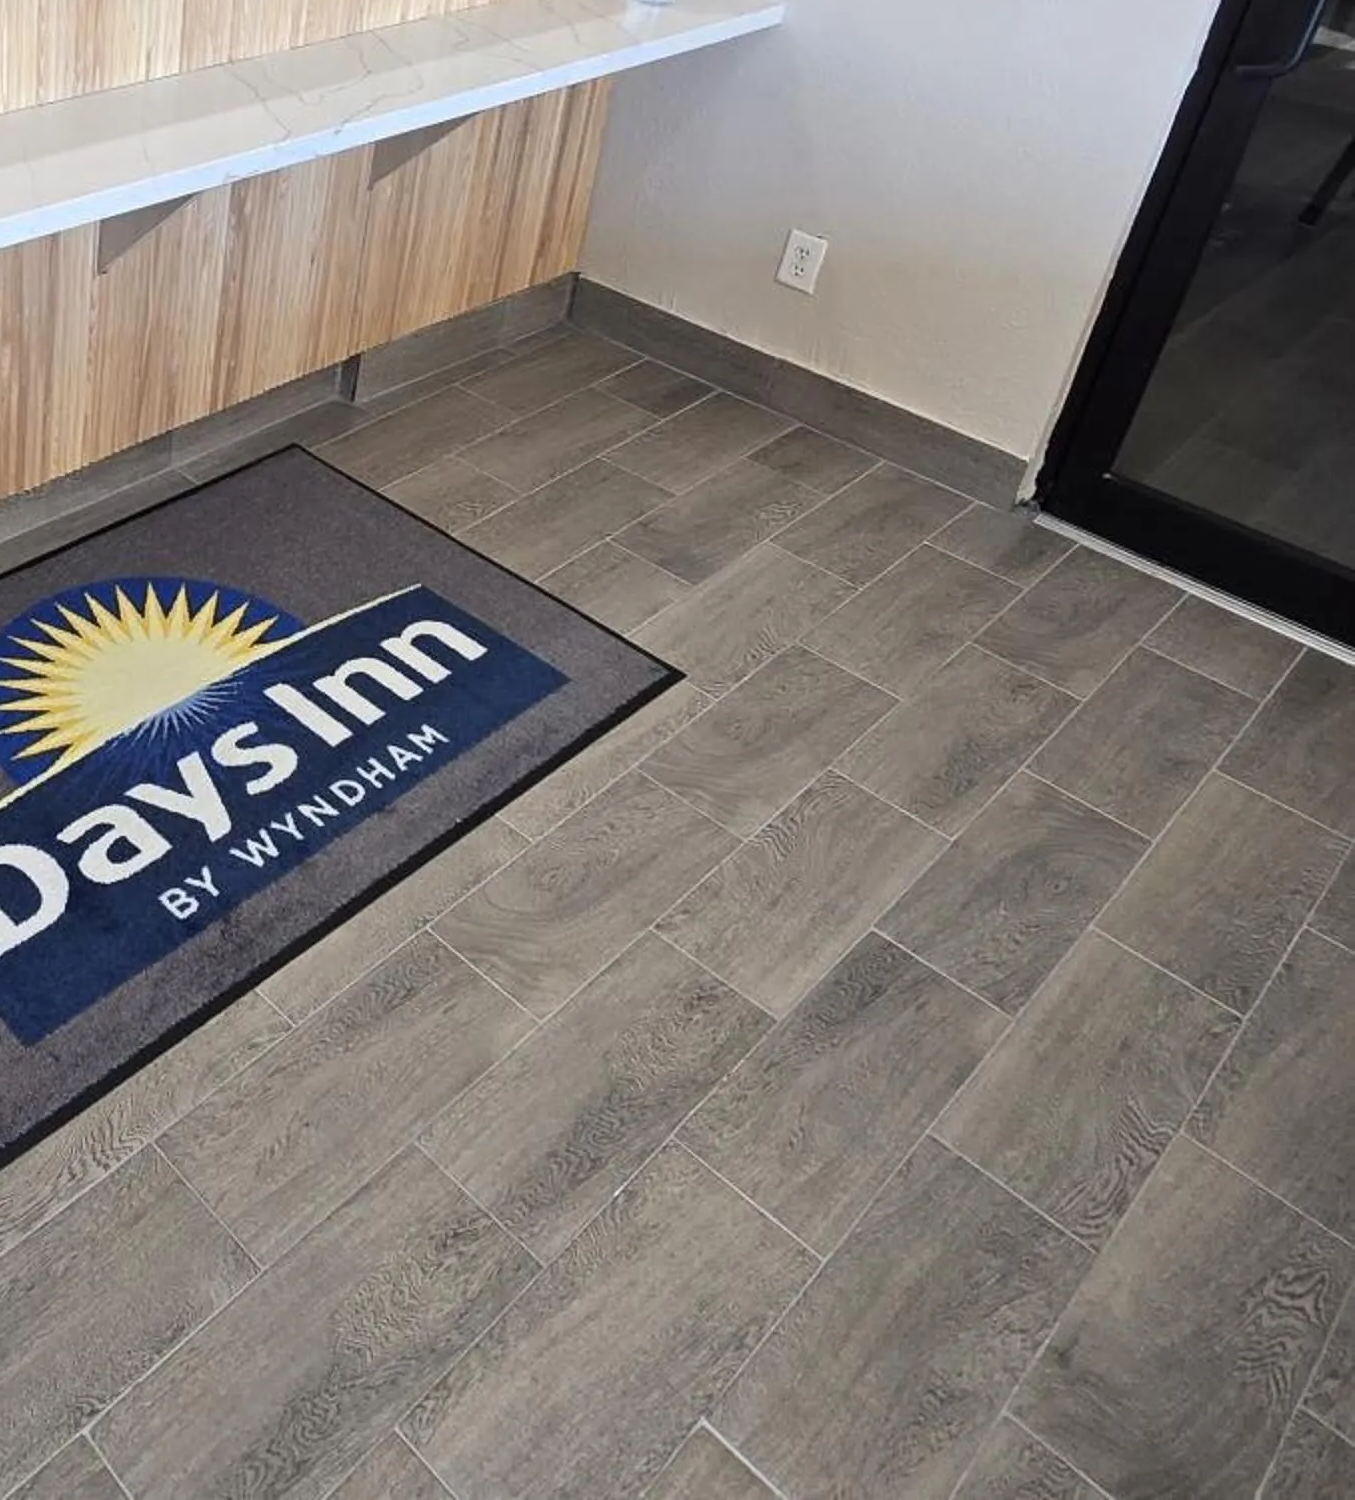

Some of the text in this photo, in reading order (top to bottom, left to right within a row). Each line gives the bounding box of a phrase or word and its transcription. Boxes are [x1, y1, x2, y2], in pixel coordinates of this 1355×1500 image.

[263, 618, 489, 748] Inn
[158, 722, 452, 922] BY WYNDHAM
